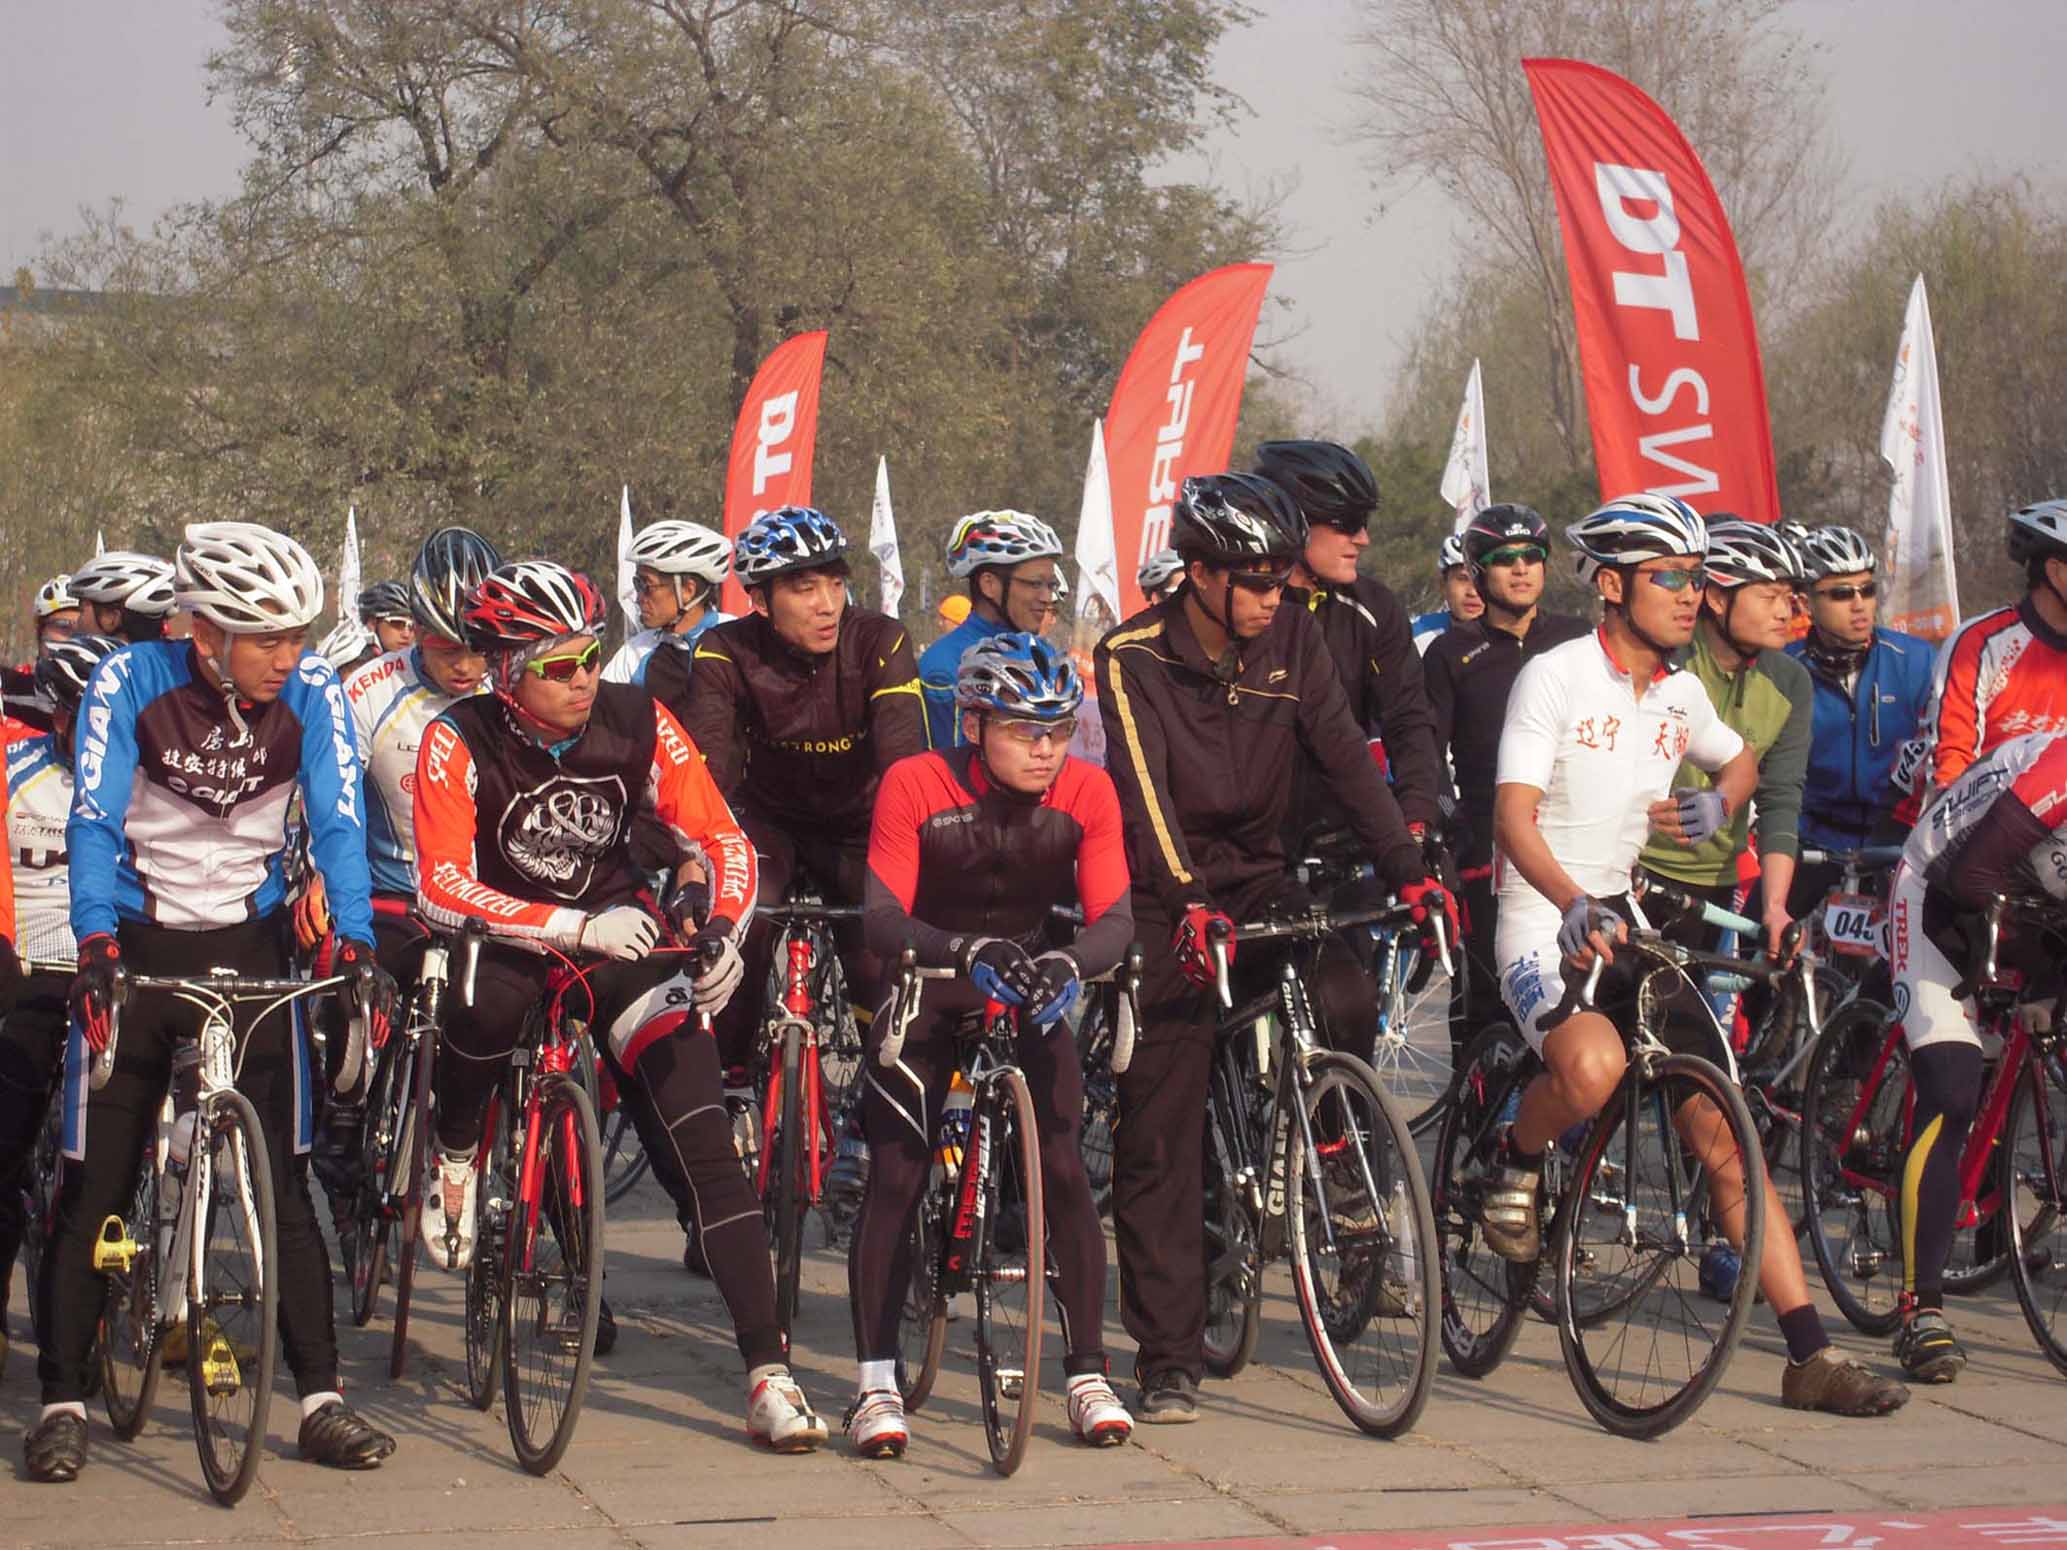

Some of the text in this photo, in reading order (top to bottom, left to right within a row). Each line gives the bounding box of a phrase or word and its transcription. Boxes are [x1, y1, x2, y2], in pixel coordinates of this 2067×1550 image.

[1594, 161, 1700, 341] DT
[80, 651, 132, 791] GIANT
[347, 656, 405, 704] KENDA
[324, 684, 361, 828] GIANT
[1896, 897, 1909, 973] TREK
[1266, 1109, 1290, 1216] GIANT
